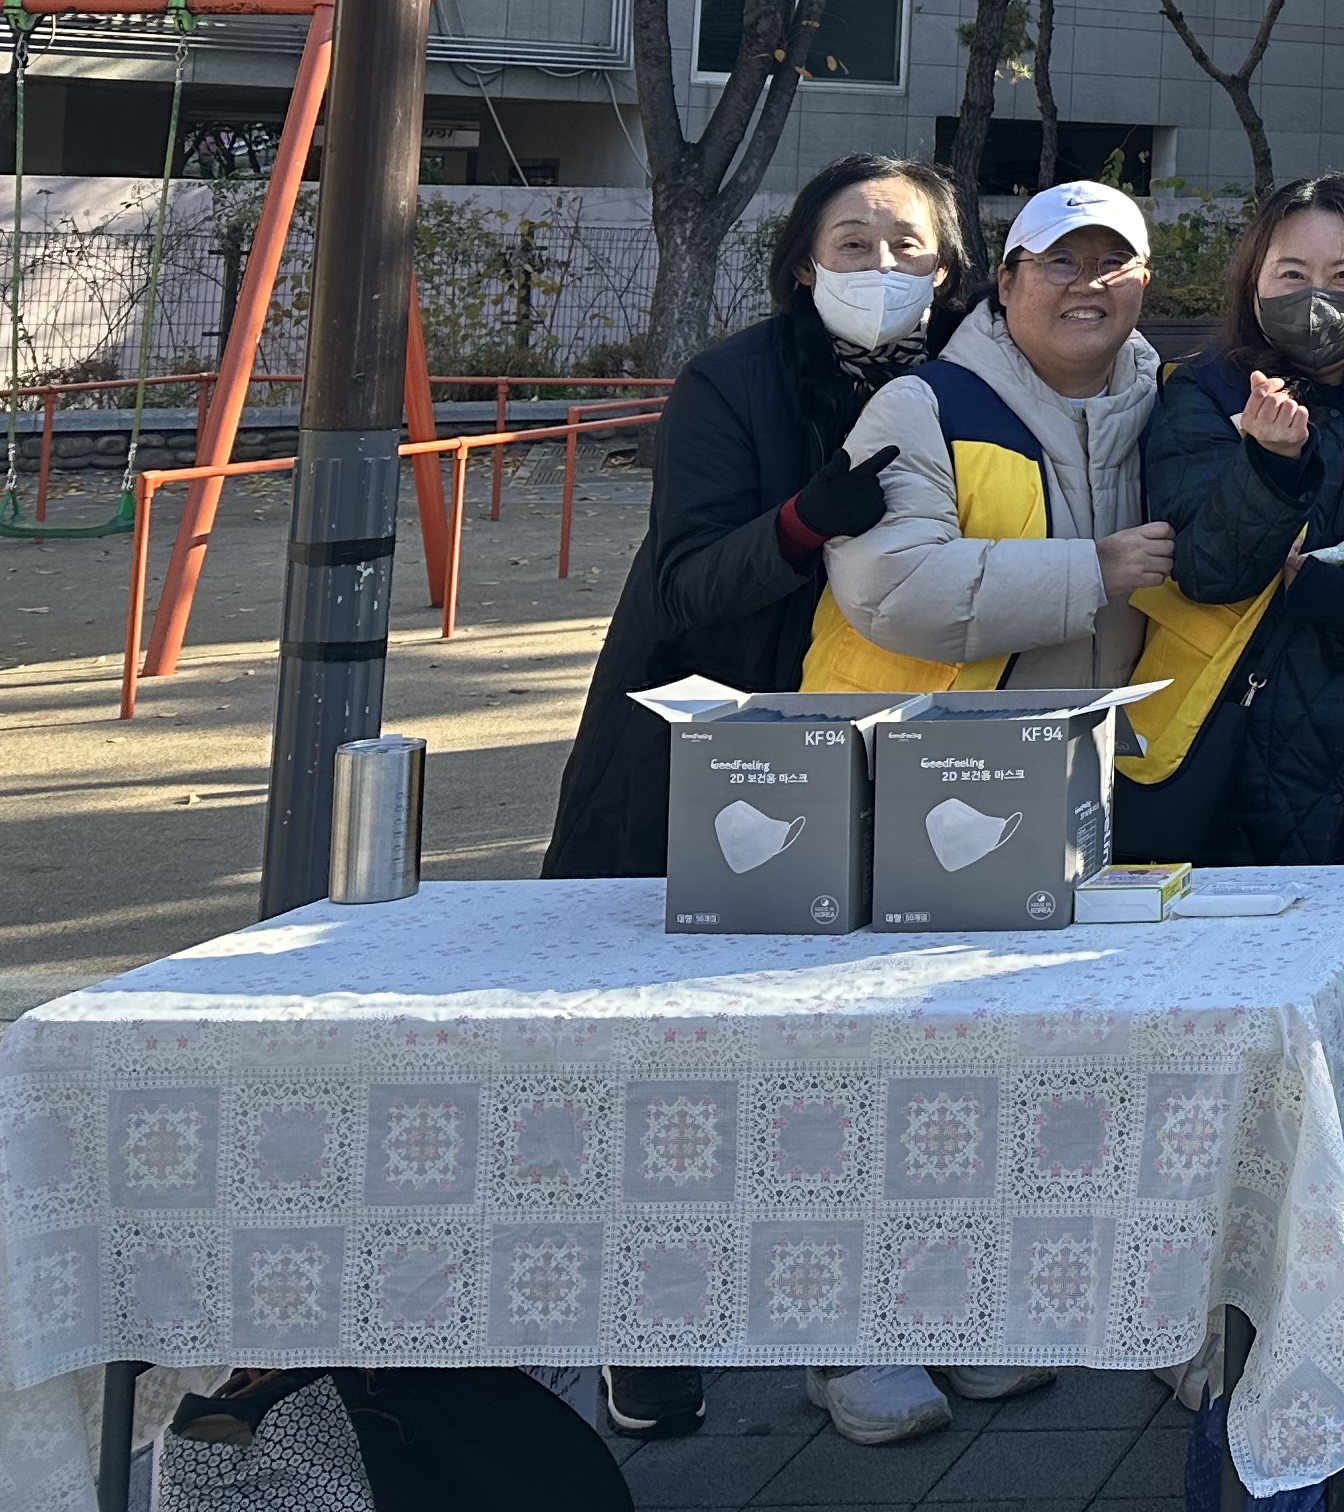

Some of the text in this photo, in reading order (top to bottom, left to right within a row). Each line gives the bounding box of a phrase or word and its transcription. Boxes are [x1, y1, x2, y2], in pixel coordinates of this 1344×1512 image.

[710, 758, 770, 772] GoodFeeling
[920, 758, 984, 770] GoodFeeling
[730, 773, 808, 784] 2D 보건용 마스크
[942, 770, 1026, 782] 2D 보건용 마스크
